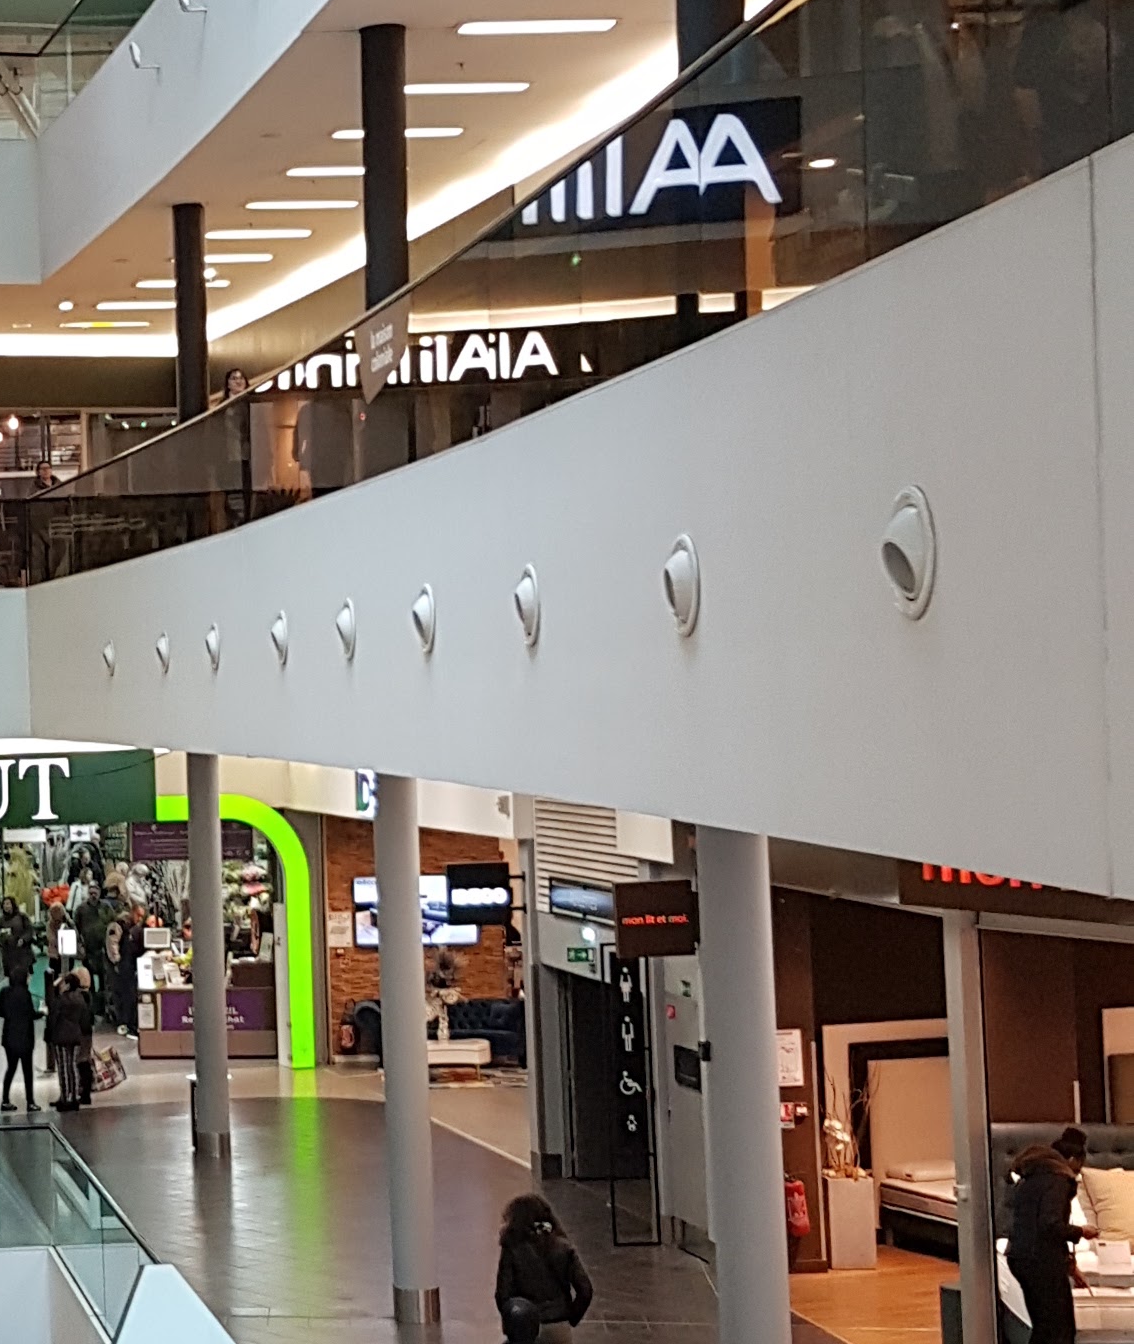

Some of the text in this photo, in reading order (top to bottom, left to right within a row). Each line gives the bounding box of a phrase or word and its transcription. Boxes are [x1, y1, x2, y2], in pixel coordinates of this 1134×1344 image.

[621, 916, 644, 926] mon
[645, 914, 655, 925] lit
[656, 914, 666, 924] et
